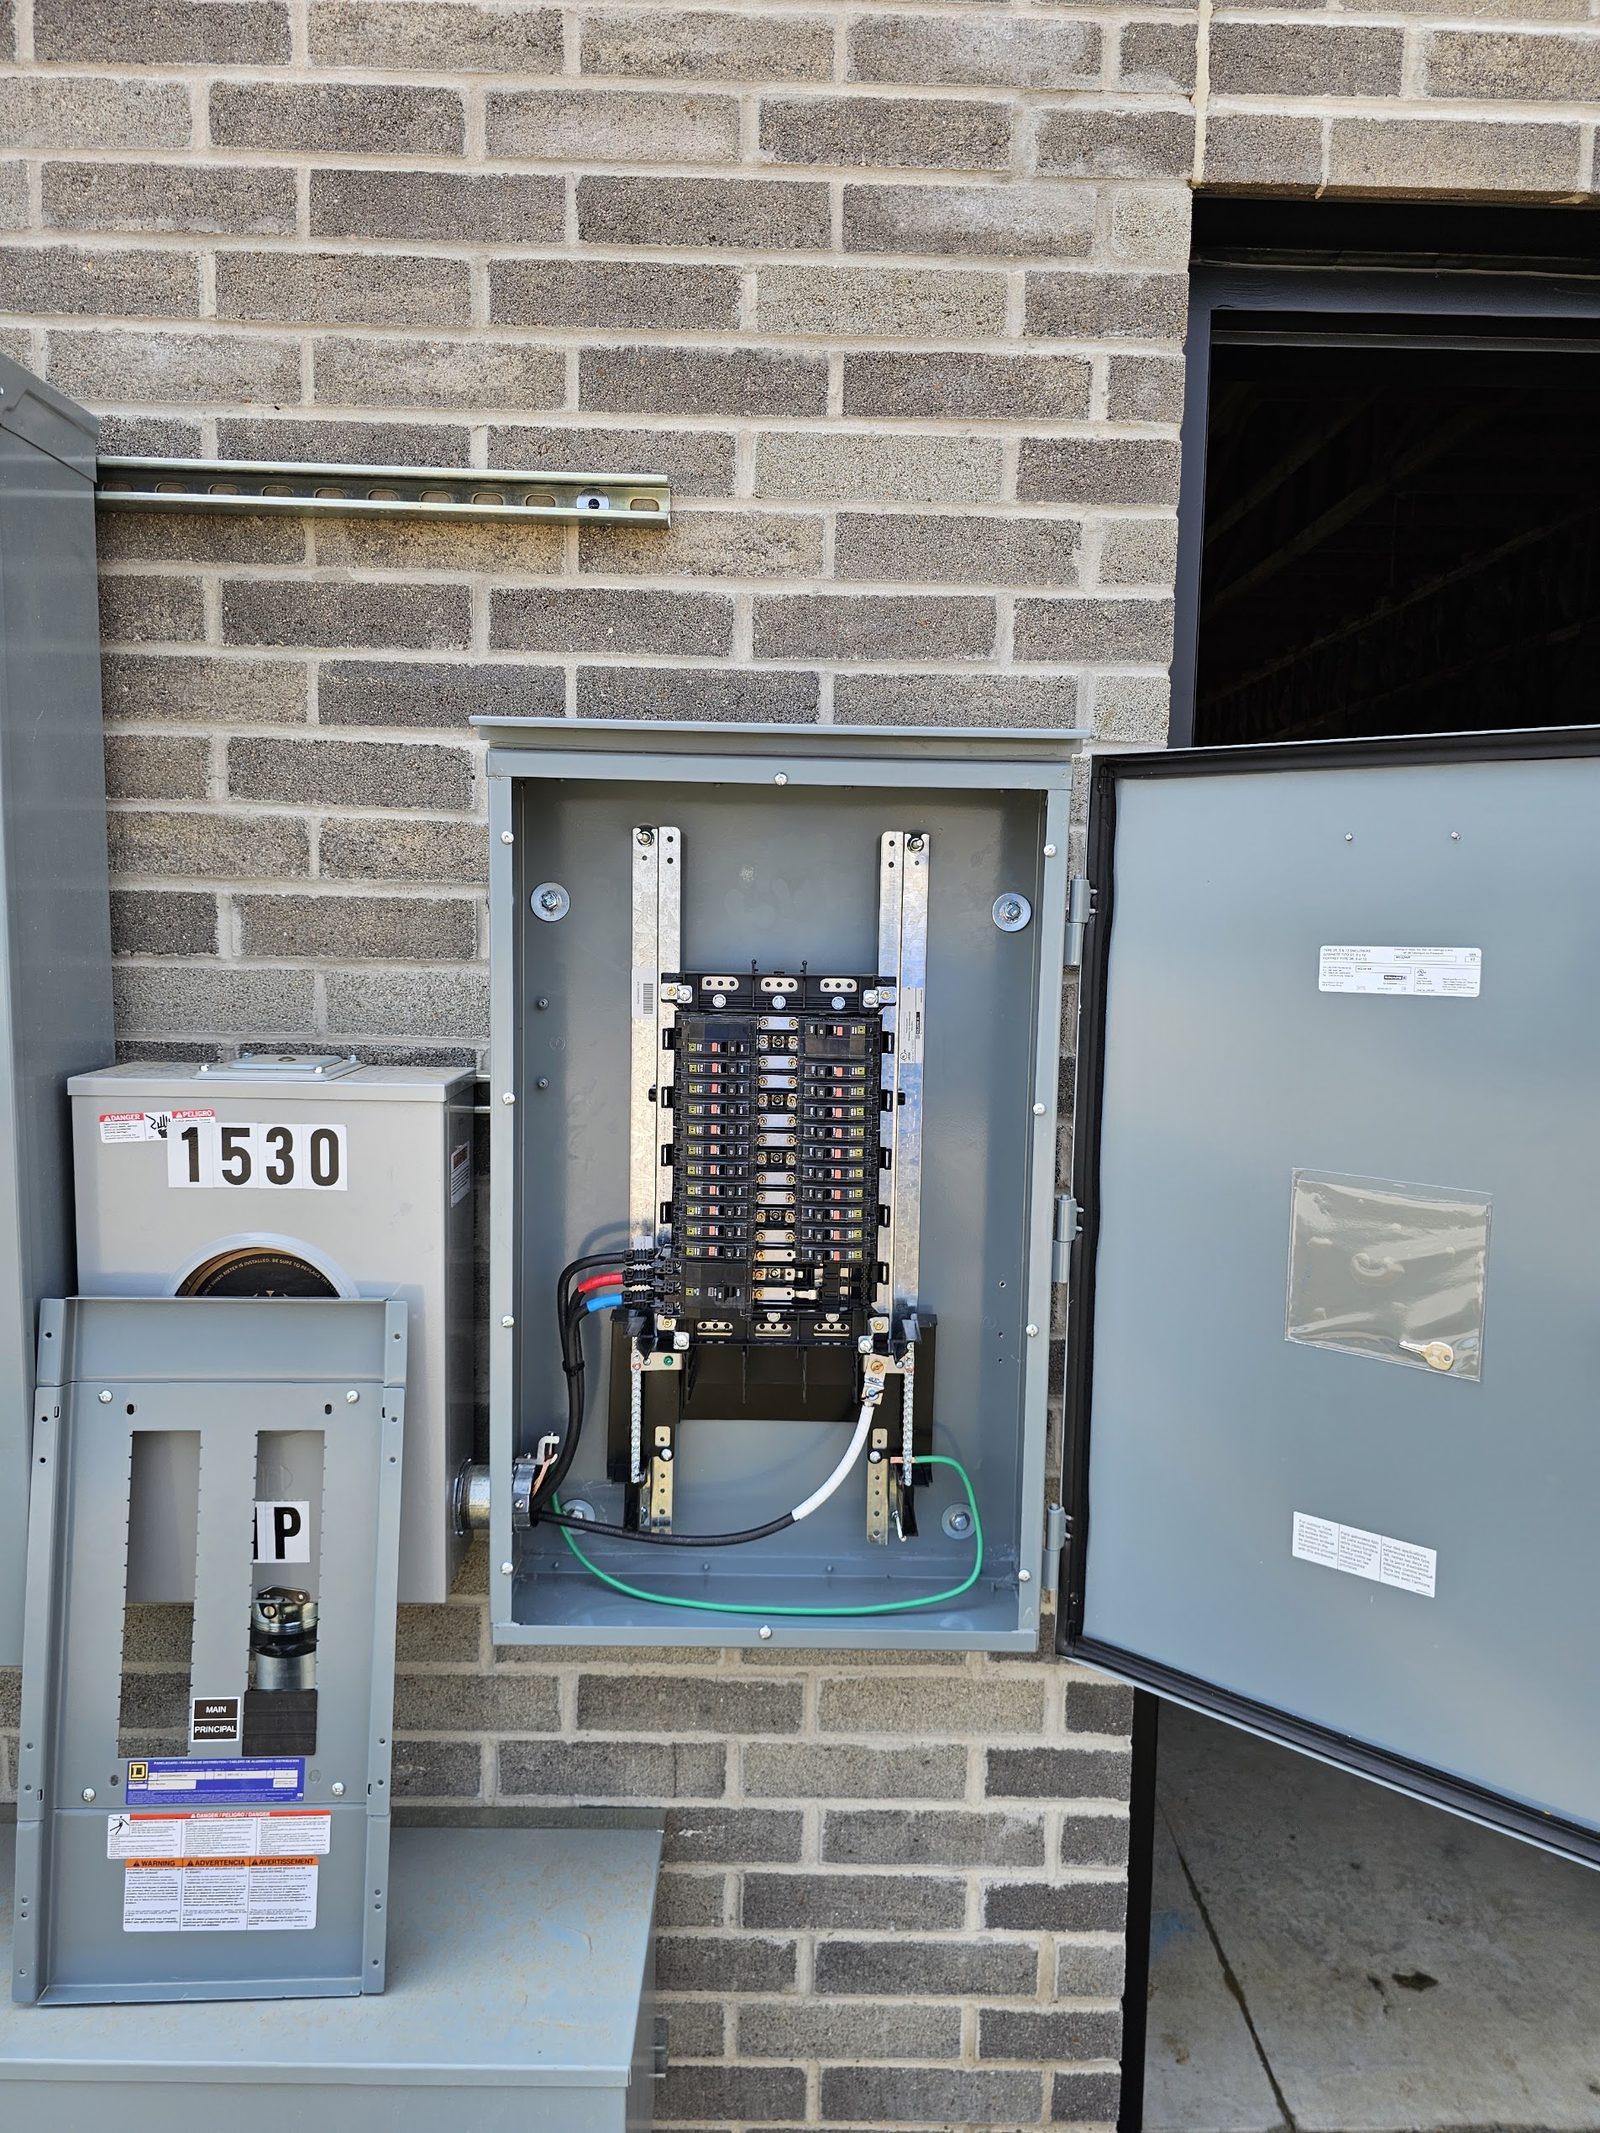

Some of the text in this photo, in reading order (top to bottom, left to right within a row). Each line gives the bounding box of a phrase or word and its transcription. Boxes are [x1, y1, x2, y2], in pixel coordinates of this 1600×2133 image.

[111, 1113, 141, 1122] DANGER
[183, 1109, 212, 1118] PELIGRO
[181, 1126, 339, 1187] 1530
[205, 1705, 227, 1714] MAIN
[194, 1725, 237, 1734] PRINCIPAL
[194, 1859, 246, 1867] ADVERTENCIA
[258, 1858, 314, 1866] AVERTISSEMENT
